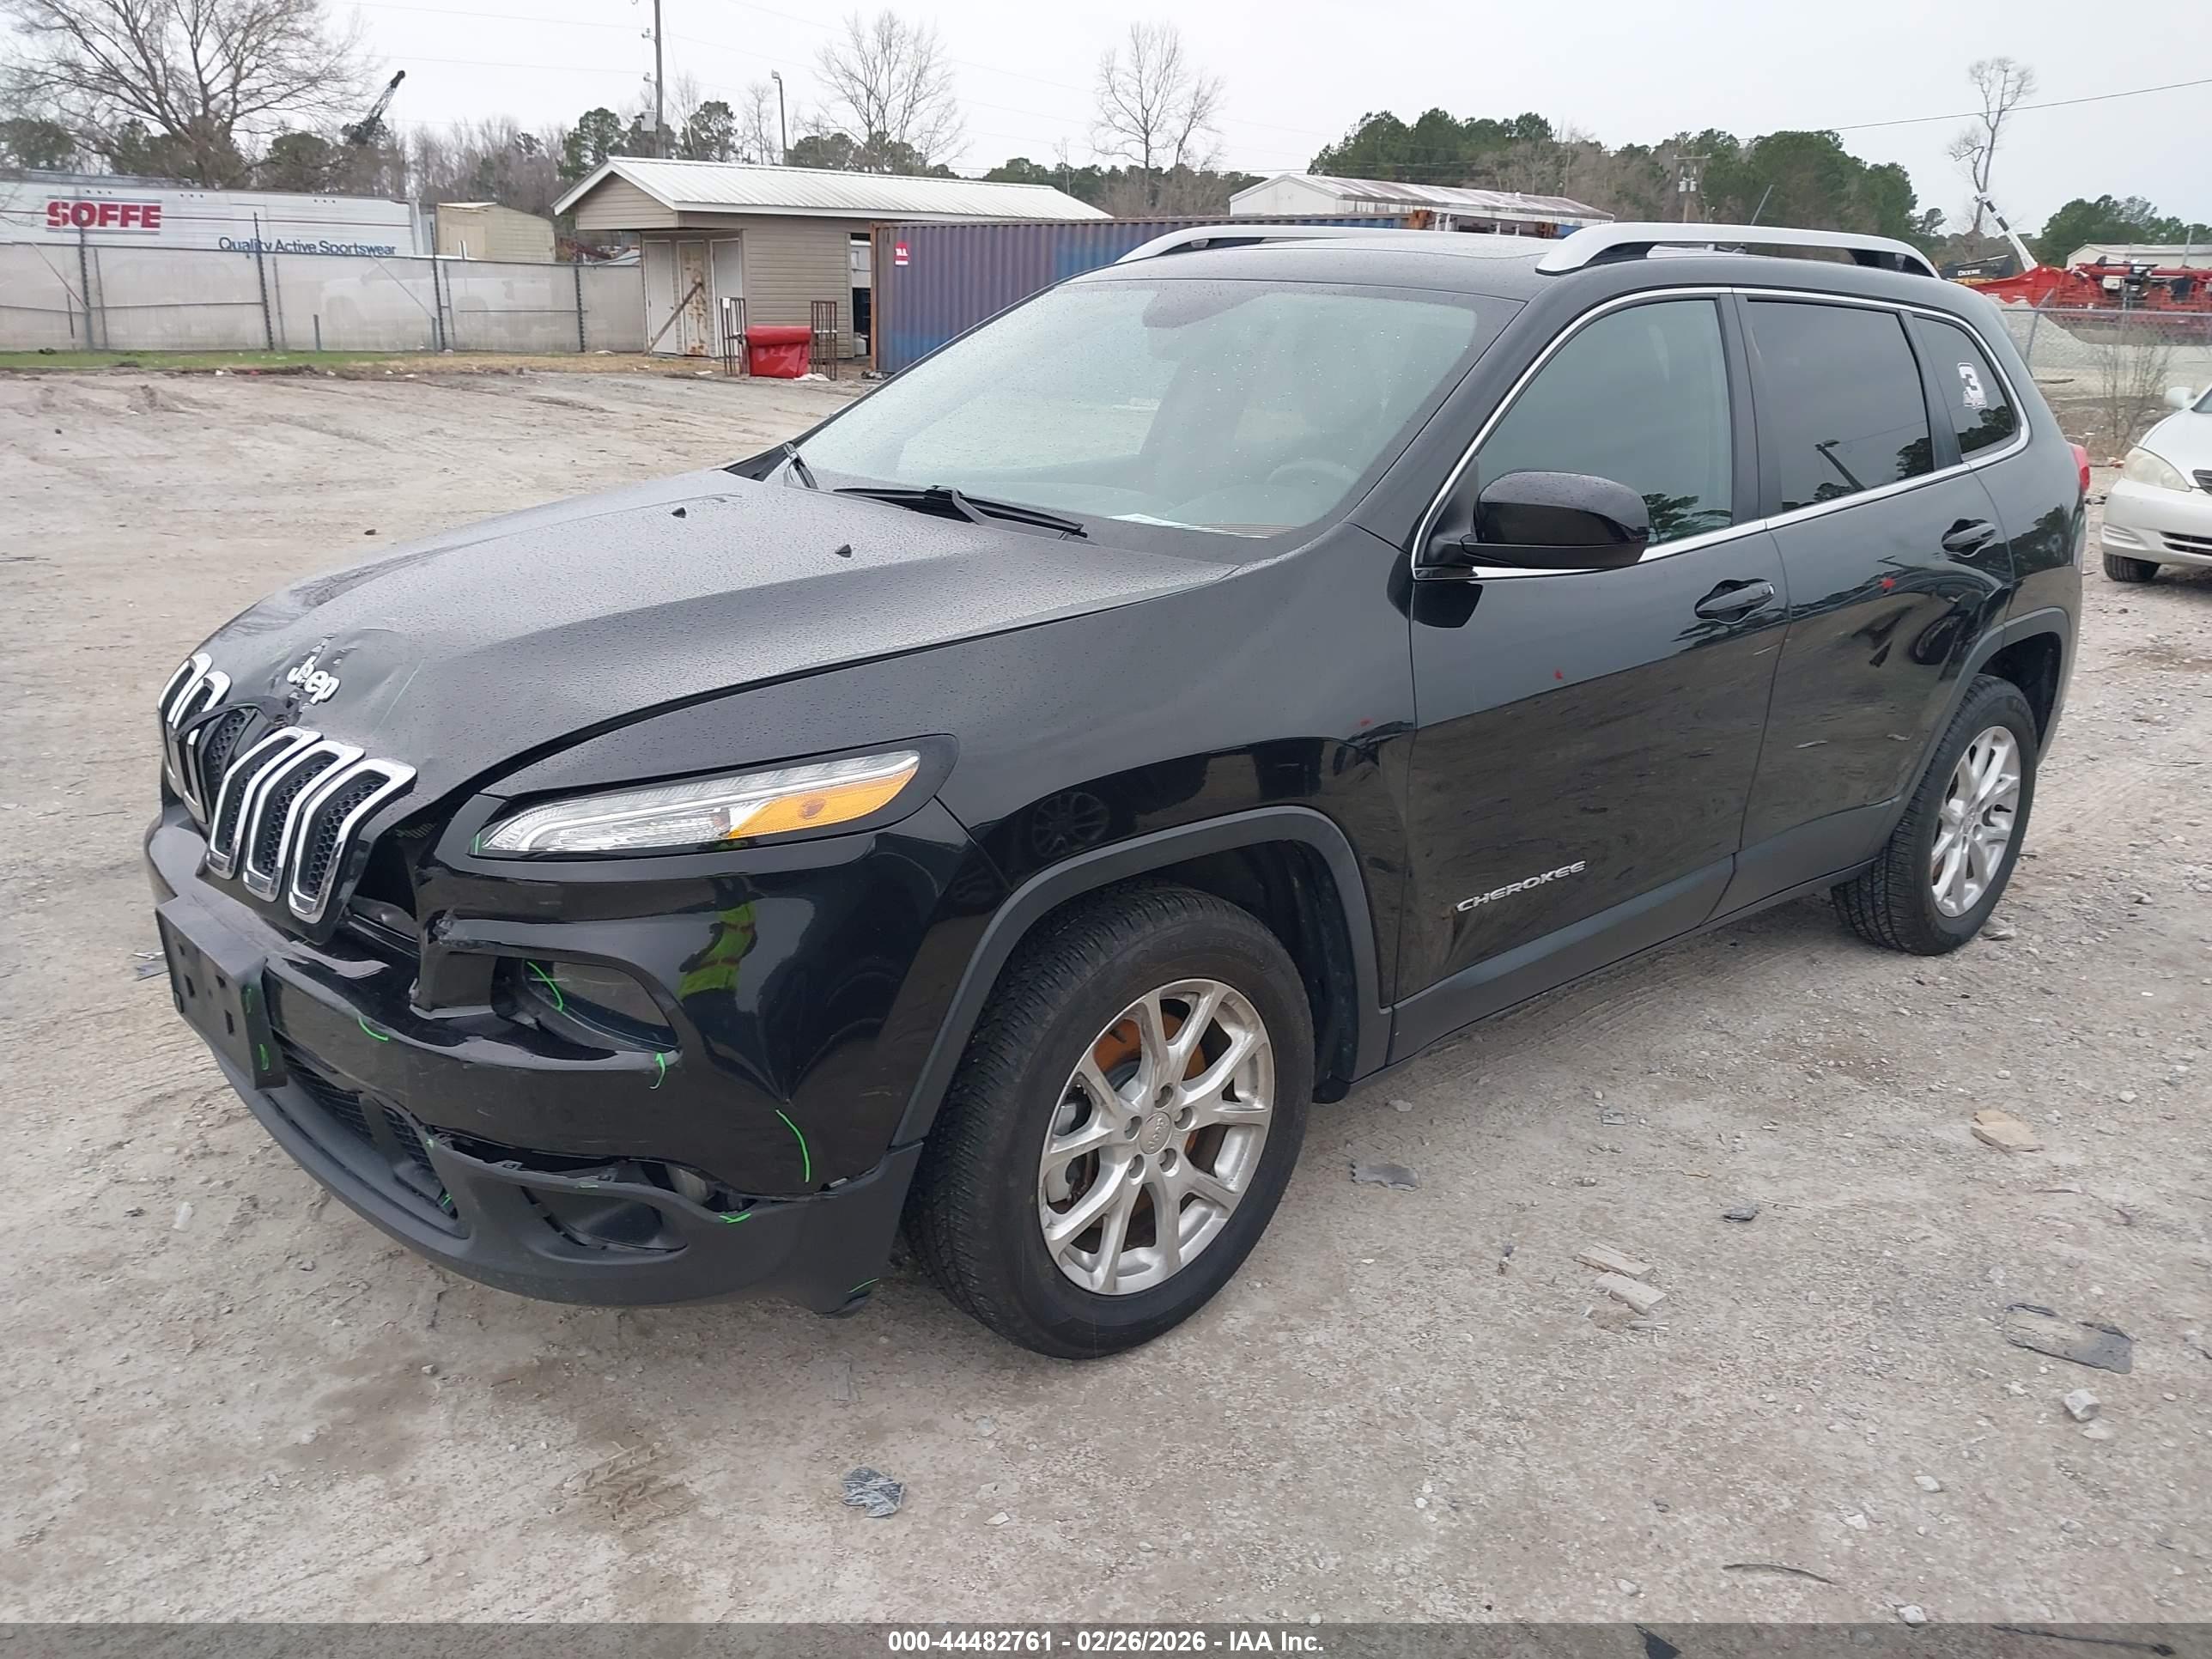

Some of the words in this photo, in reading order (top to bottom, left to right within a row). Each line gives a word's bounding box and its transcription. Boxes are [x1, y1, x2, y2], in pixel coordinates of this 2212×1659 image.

[47, 201, 161, 228] SOFFE
[275, 239, 317, 252] Active
[319, 240, 397, 256] Sportswear
[287, 655, 340, 704] Jeep
[1456, 860, 1587, 912] CHEROKEE
